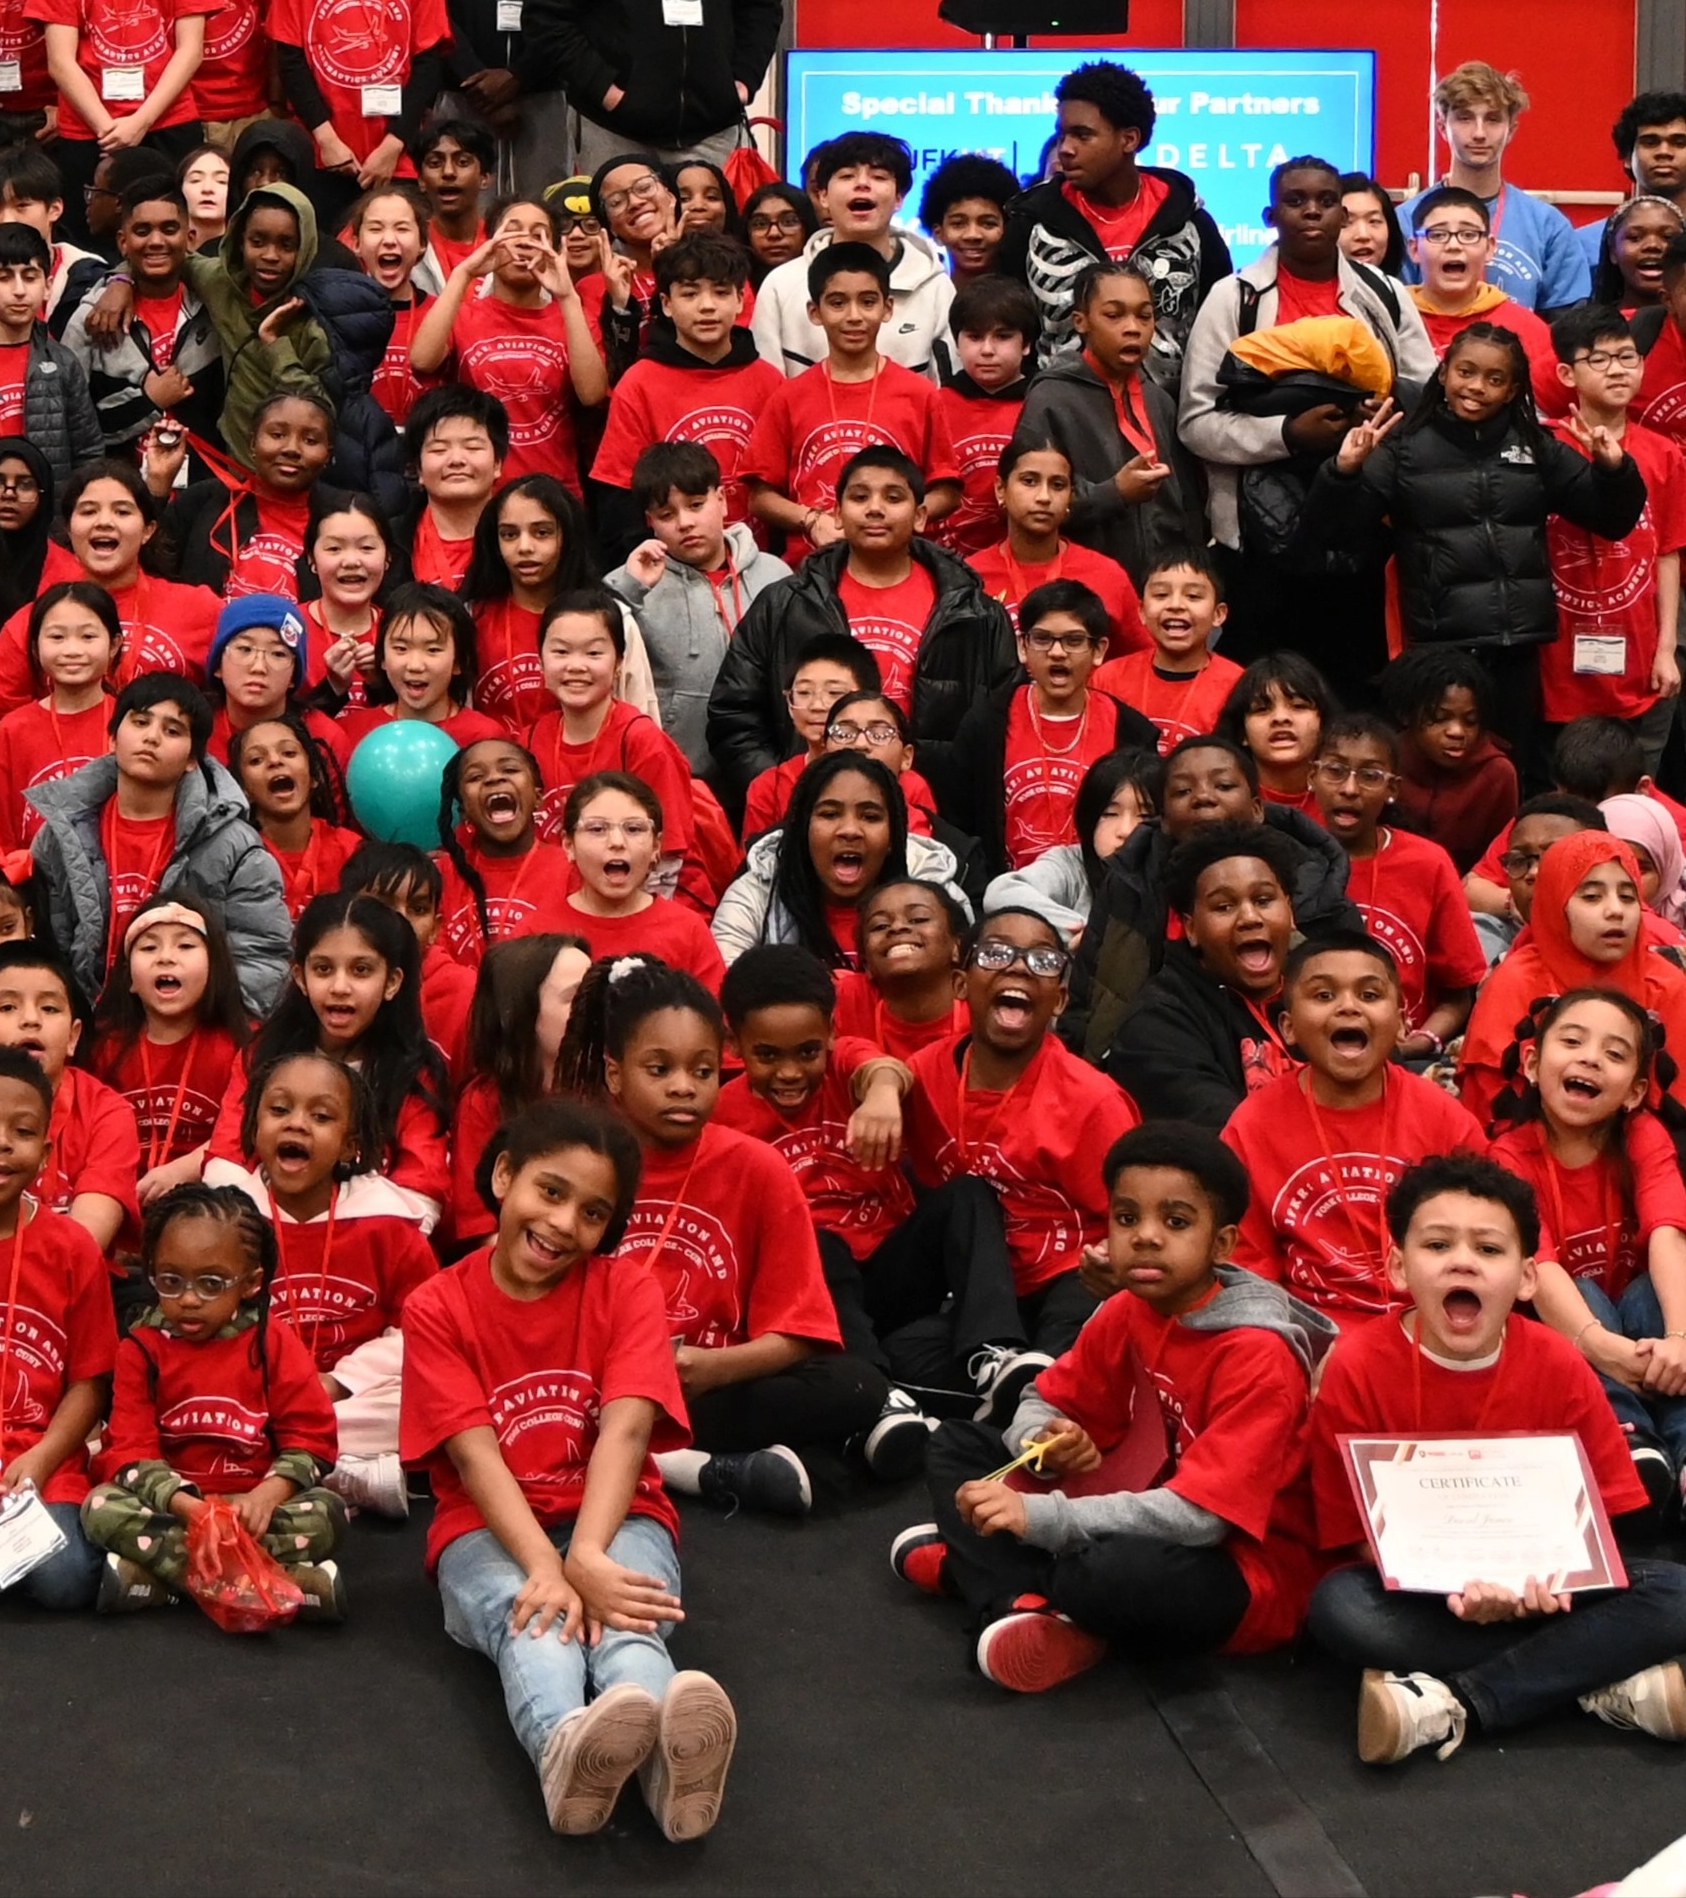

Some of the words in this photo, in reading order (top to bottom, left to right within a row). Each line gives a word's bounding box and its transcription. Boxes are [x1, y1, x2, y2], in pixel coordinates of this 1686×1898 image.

[841, 91, 956, 120] Special
[963, 91, 1059, 115] Thank
[1153, 97, 1182, 115] ur
[1189, 91, 1321, 115] Partners
[1155, 142, 1289, 169] DELTA
[41, 1338, 66, 1372] AND
[1419, 1476, 1523, 1490] CERTIFICATE
